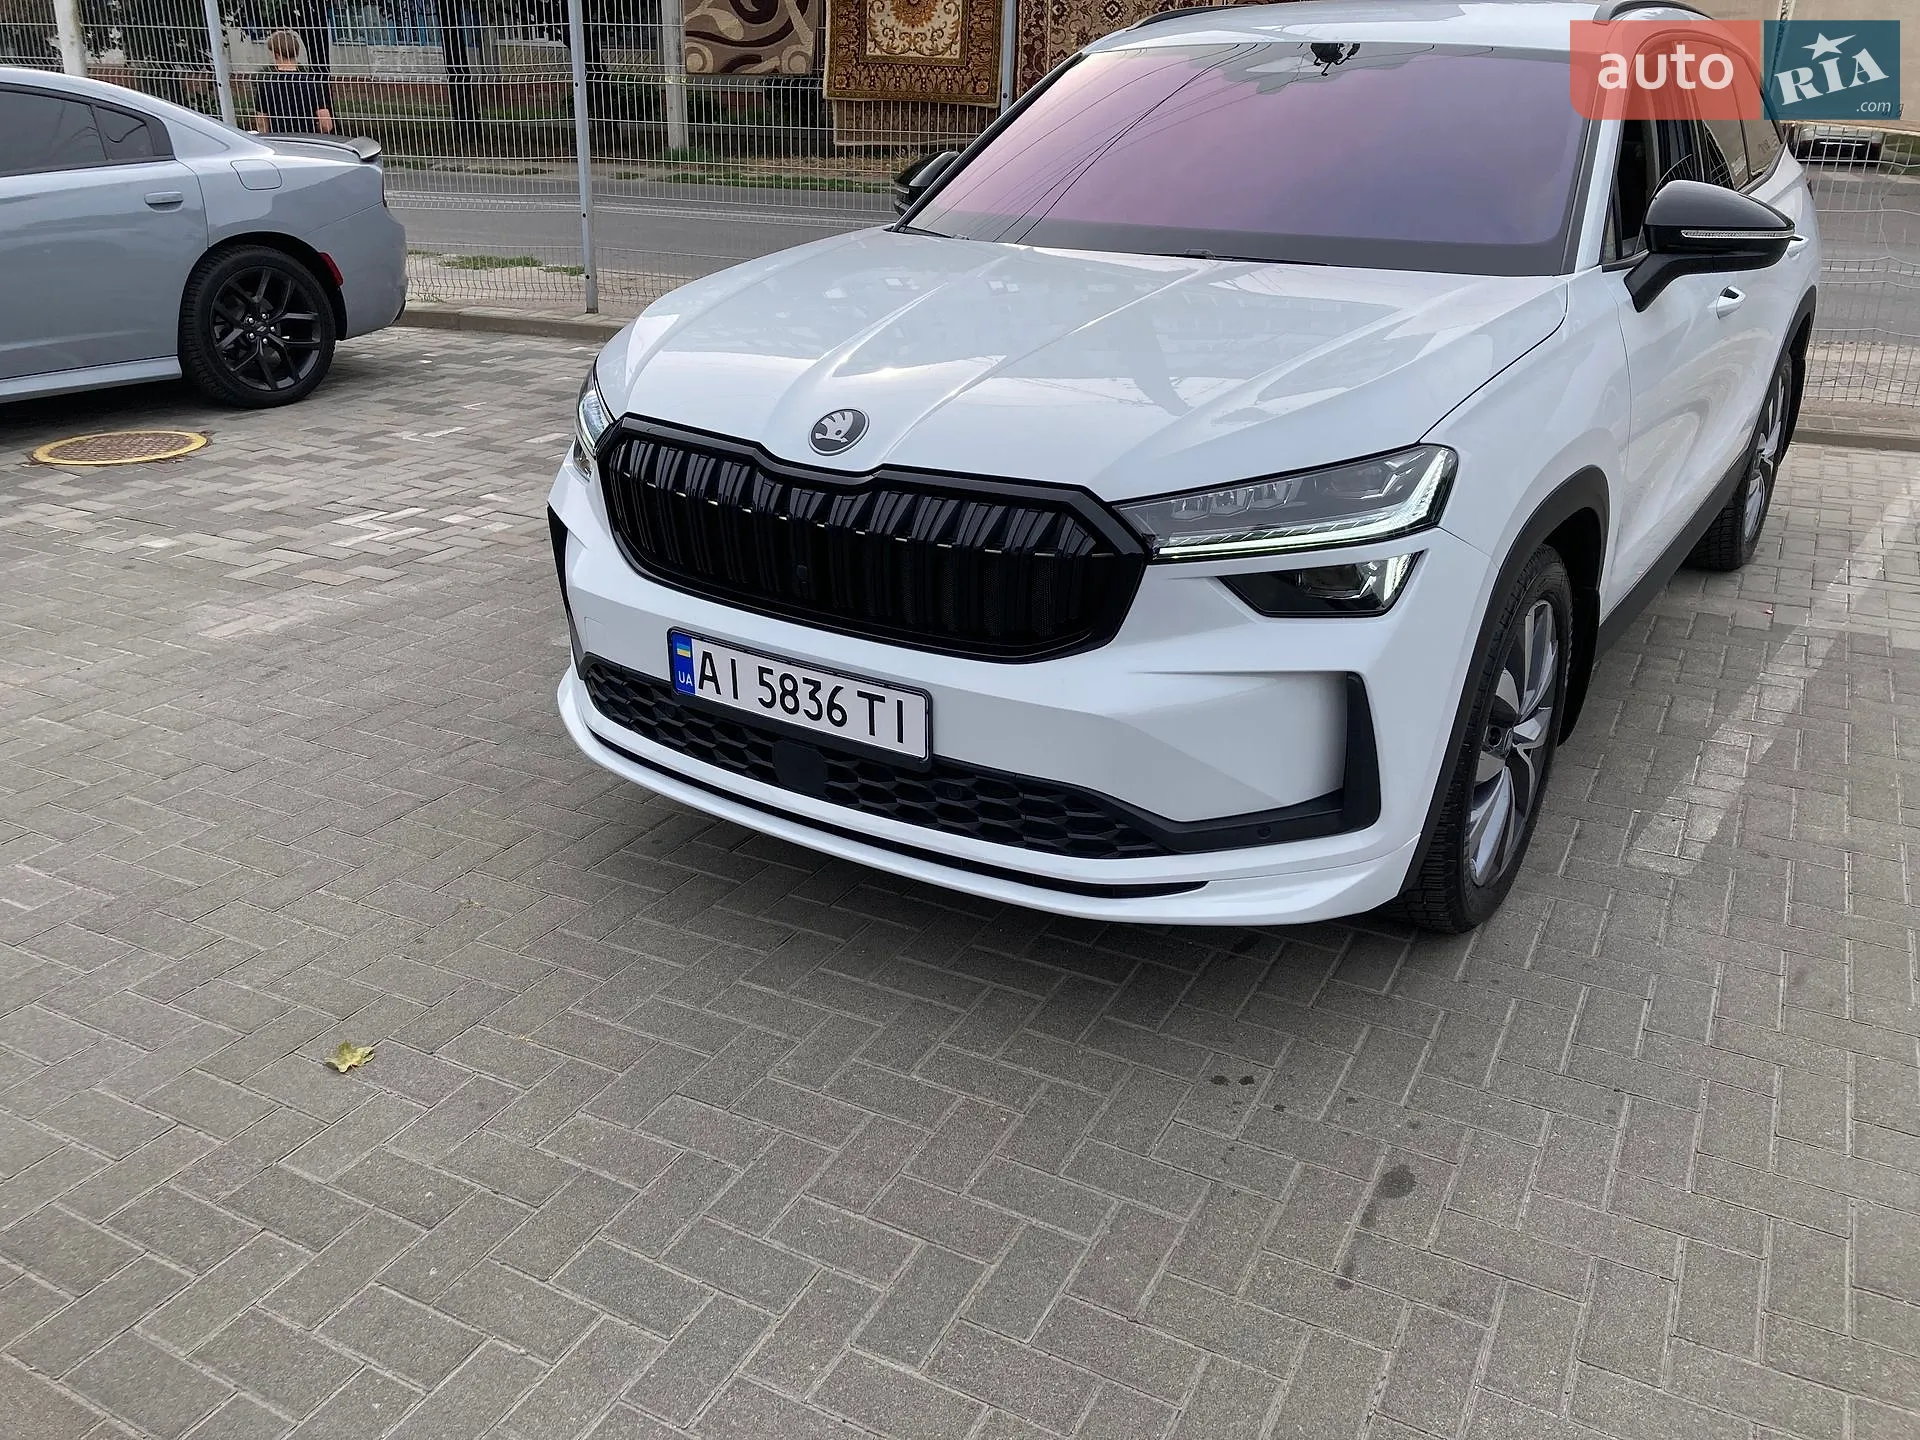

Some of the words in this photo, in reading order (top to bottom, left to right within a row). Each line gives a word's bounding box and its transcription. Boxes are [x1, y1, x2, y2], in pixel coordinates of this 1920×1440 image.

[678, 670, 693, 687] UA
[698, 650, 739, 700] AI
[757, 665, 848, 727] 5836
[856, 689, 904, 743] TI
